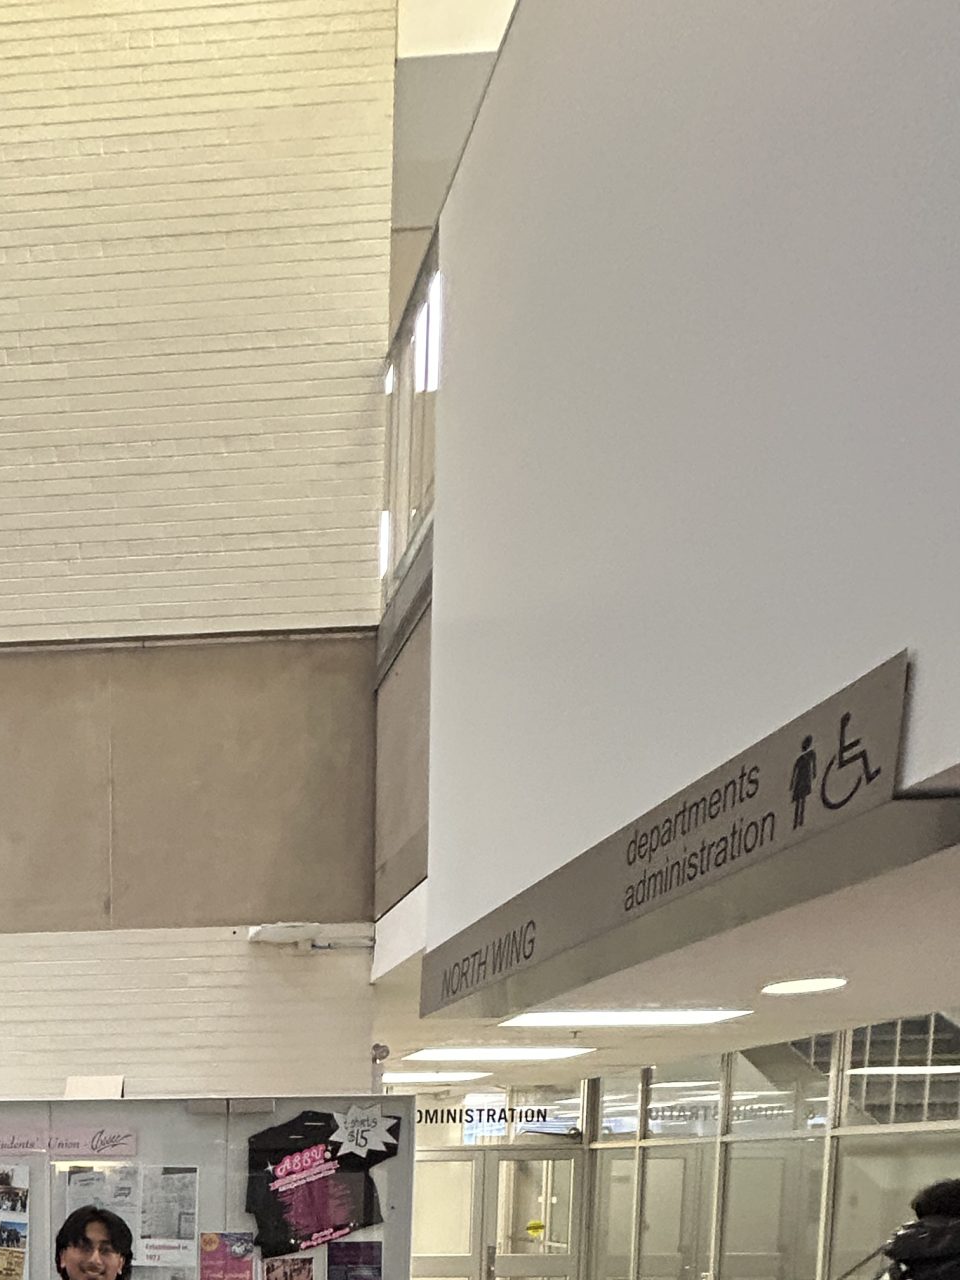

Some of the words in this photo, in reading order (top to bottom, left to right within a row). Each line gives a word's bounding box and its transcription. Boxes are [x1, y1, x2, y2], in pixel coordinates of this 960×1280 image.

[625, 764, 760, 866] departments
[623, 811, 776, 912] administration
[441, 945, 489, 1000] NORTH
[492, 919, 537, 976] WING
[47, 1136, 80, 1149] Union
[416, 1108, 548, 1124] DMINISTRATION
